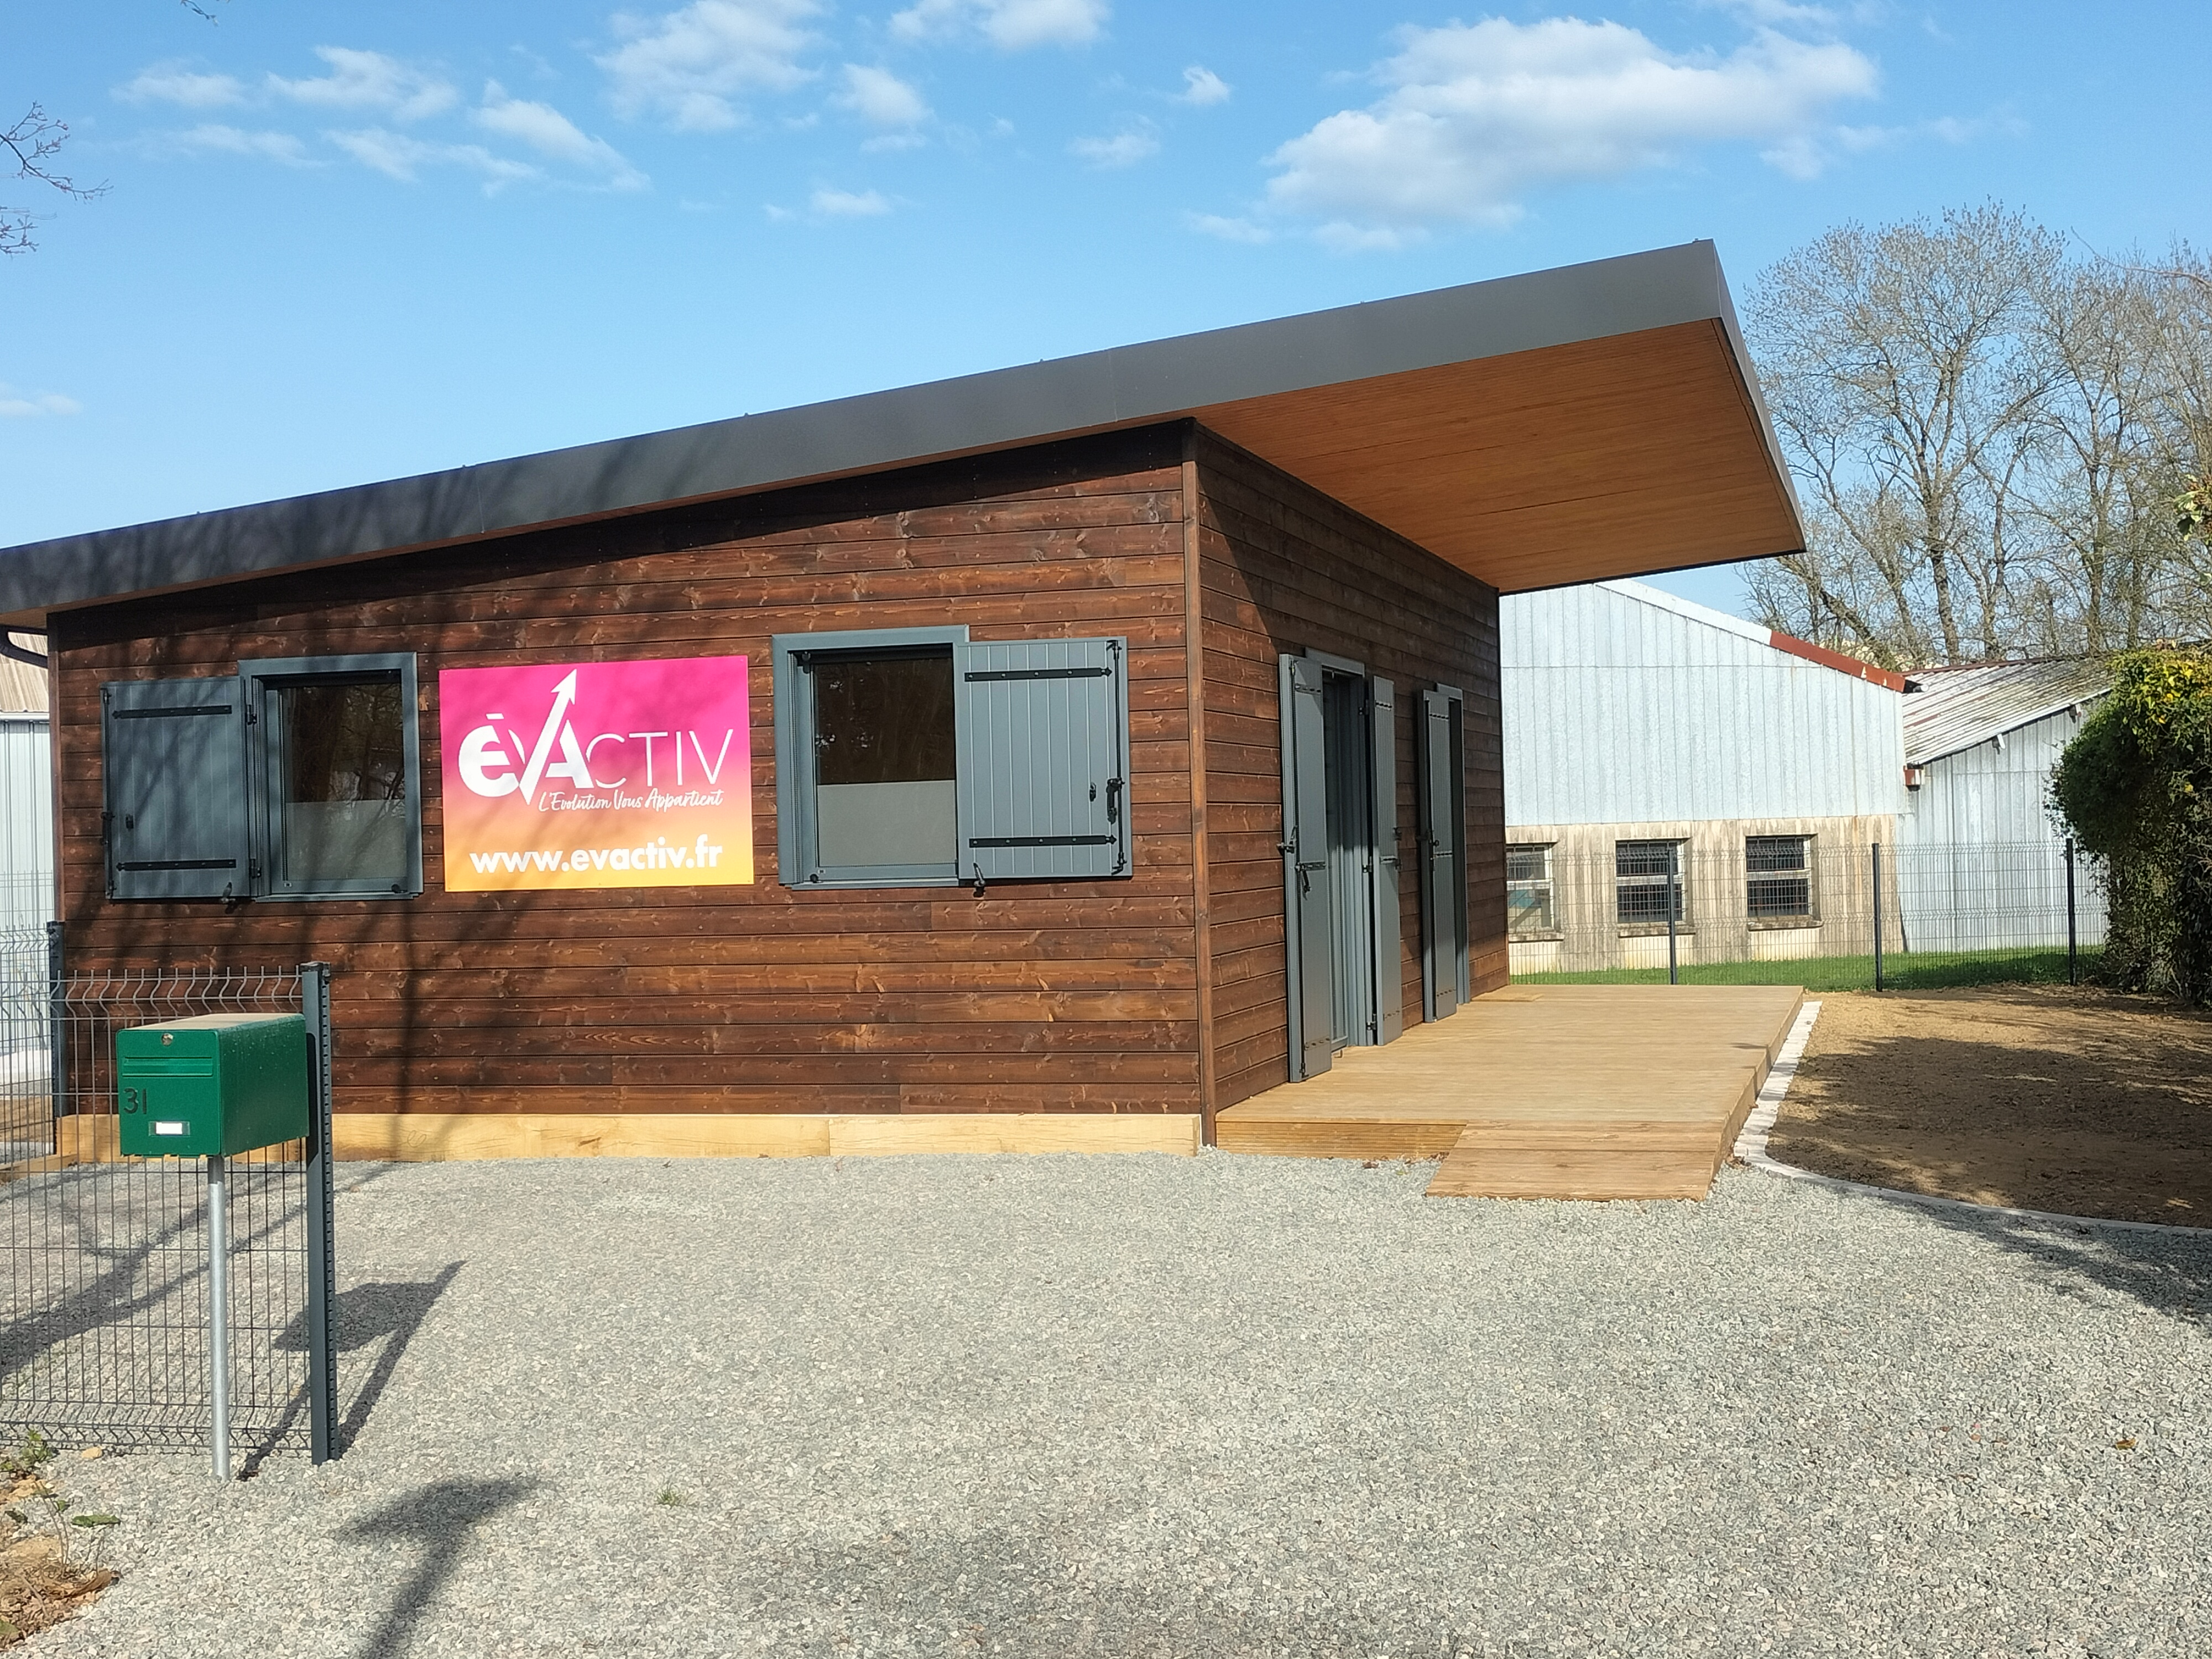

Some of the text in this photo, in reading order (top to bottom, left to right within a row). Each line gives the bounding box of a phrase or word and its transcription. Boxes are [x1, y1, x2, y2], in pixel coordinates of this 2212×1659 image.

[613, 789, 645, 810] Vous
[644, 787, 724, 812] Appartient
[469, 833, 723, 874] www.evactiv.fr
[123, 1087, 147, 1114] 31
